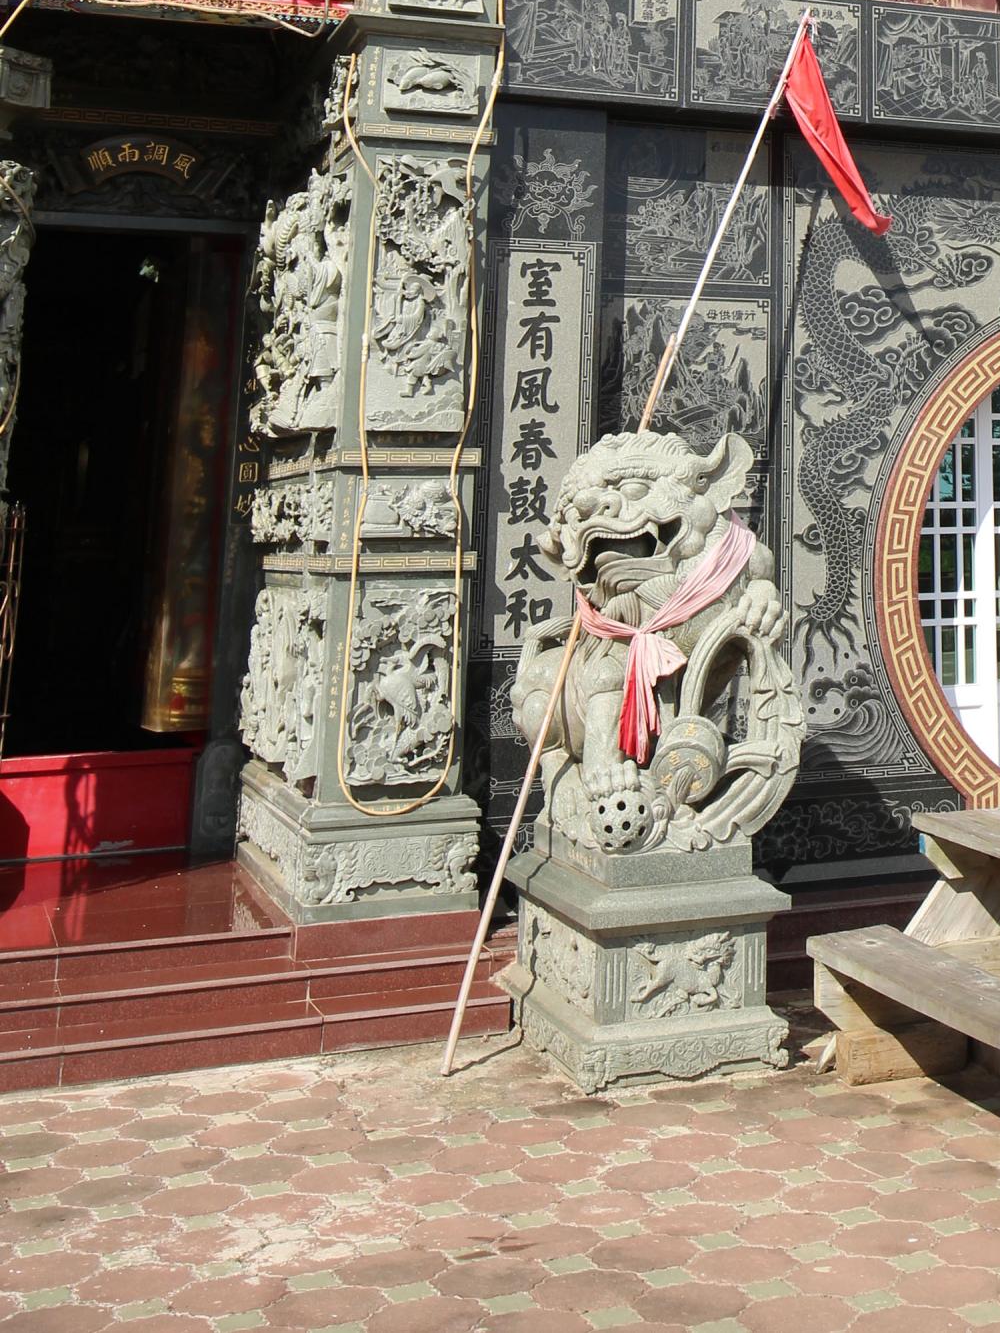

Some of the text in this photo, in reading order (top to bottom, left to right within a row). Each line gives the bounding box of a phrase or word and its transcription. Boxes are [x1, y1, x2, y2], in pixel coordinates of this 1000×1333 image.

[87, 141, 196, 180] 風調雨順
[503, 258, 562, 640] 室有風春鼓太和
